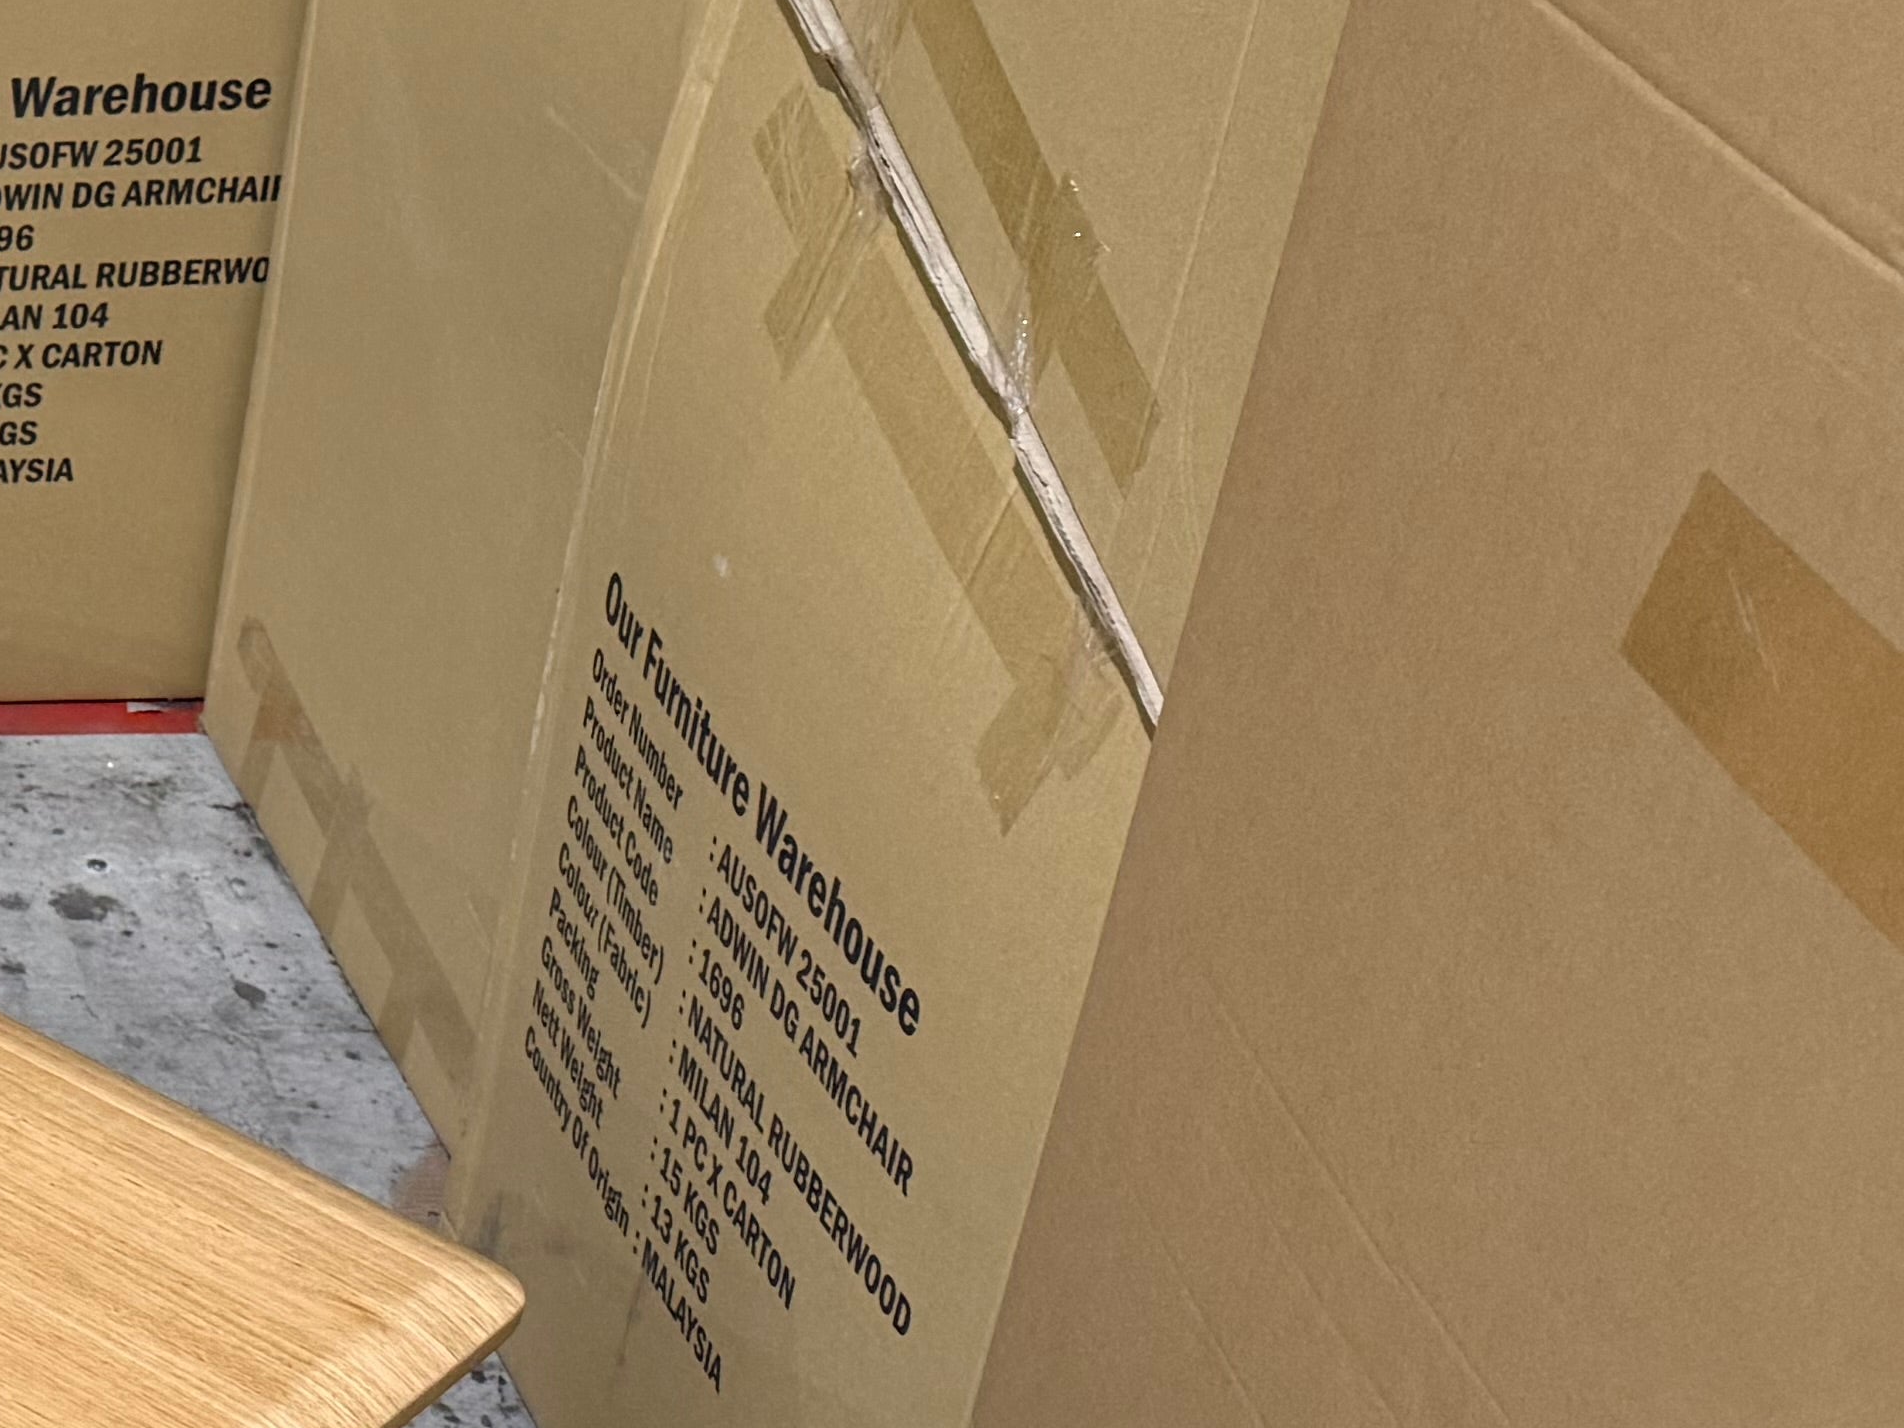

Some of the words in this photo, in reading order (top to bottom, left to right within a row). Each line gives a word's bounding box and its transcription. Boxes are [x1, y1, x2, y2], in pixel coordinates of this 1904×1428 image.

[11, 73, 271, 118] Warehouse
[13, 343, 35, 369] X
[41, 340, 163, 369] CARTON
[582, 695, 633, 801] Product
[633, 777, 672, 865] Name
[706, 896, 769, 1000] ADWIN
[769, 979, 799, 1044] DG
[798, 1025, 913, 1198] ARMCHAIR
[605, 572, 643, 660] Our
[642, 627, 749, 817] Furniture
[755, 781, 920, 1037] Warehouse
[567, 795, 608, 882] Colour
[606, 866, 664, 986] (Timber)
[687, 994, 764, 1135] NATURAL
[767, 1113, 911, 1337] RUBBERWOOD
